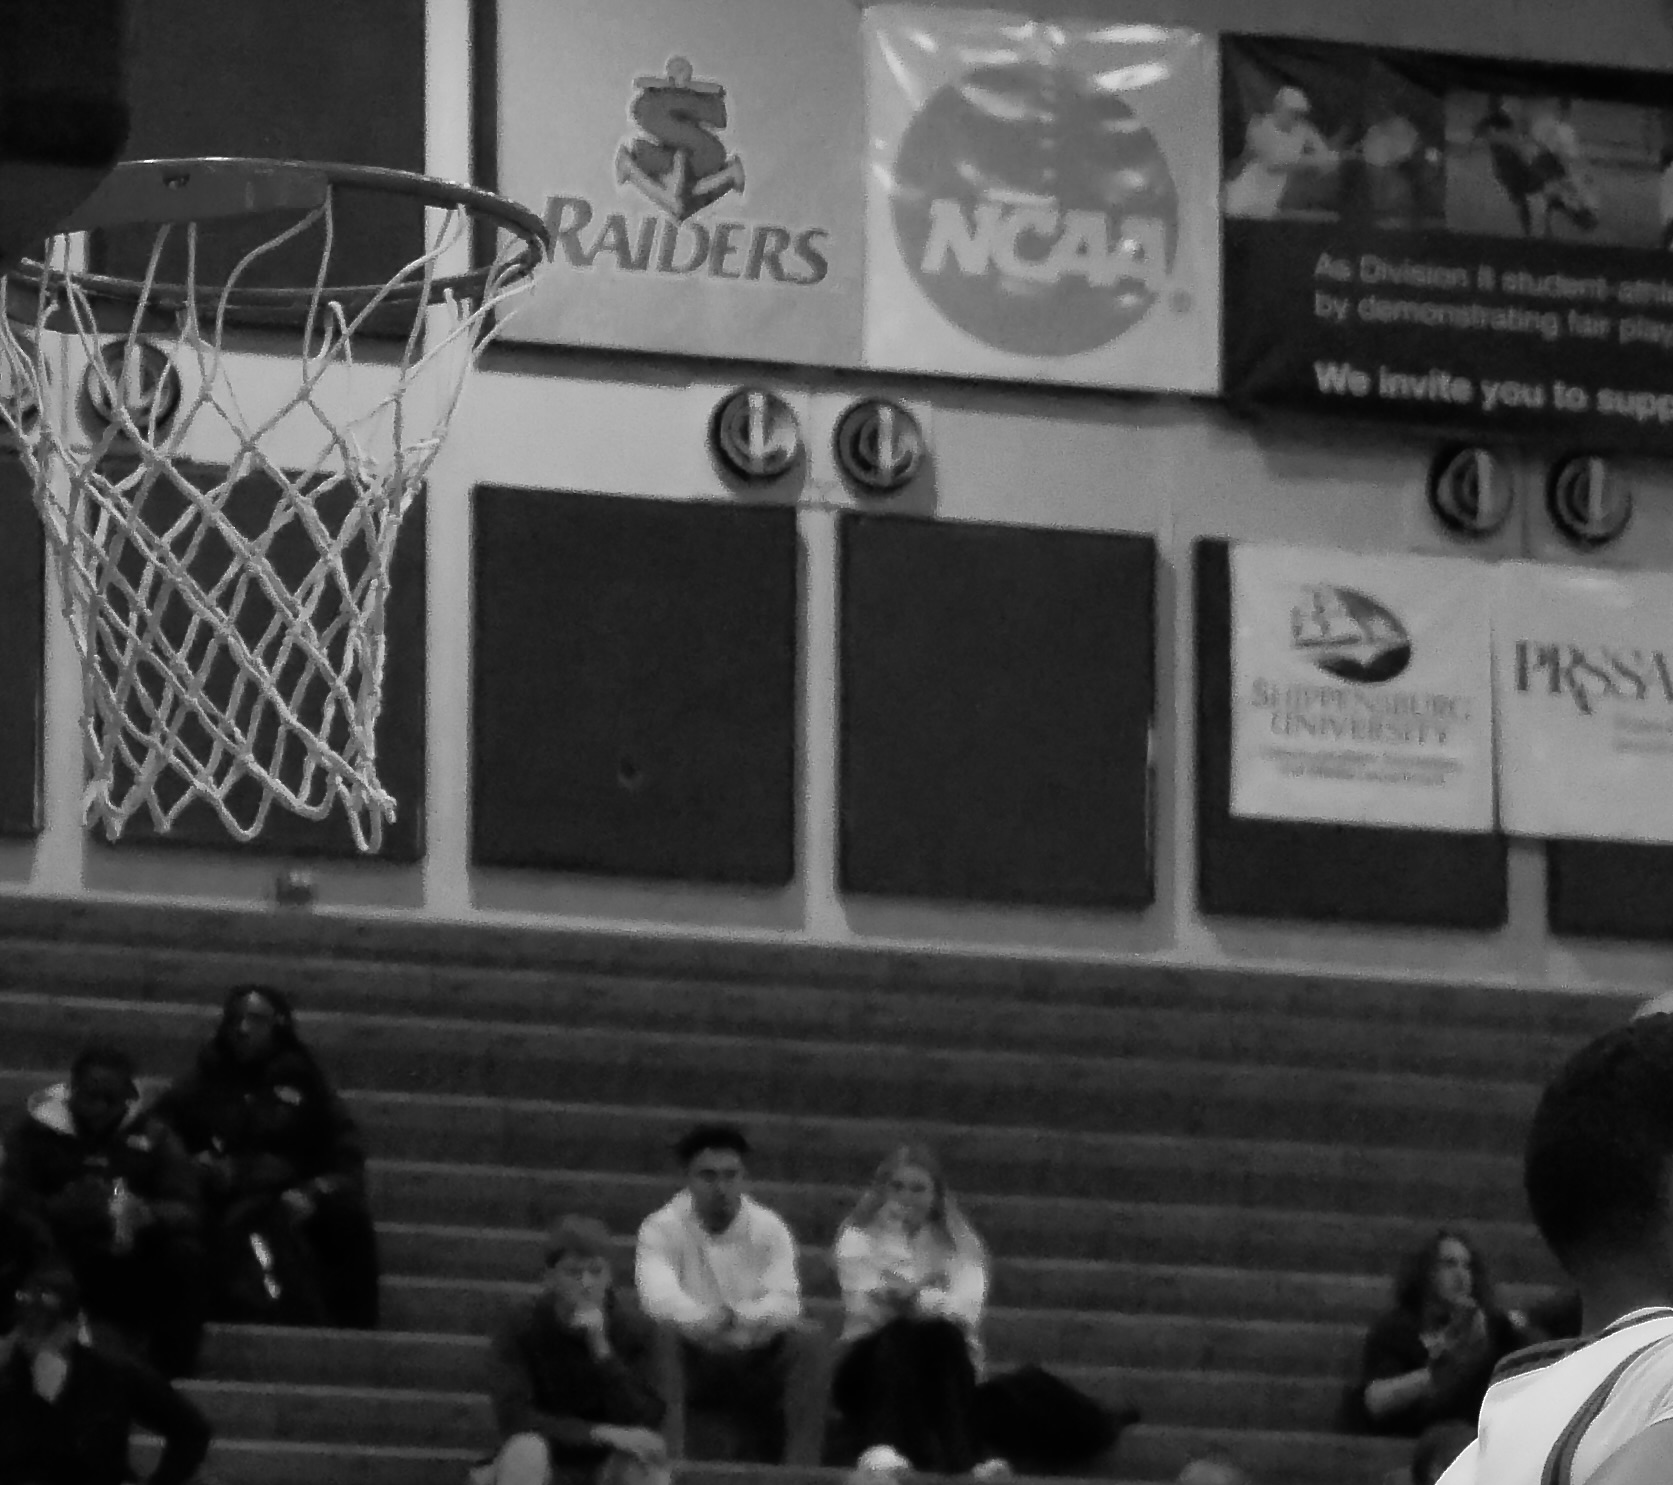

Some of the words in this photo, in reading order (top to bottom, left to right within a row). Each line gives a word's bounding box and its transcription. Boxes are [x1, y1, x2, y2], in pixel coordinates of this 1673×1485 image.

[545, 195, 829, 287] RAIDERS
[920, 198, 1173, 288] NCAA
[1360, 254, 1469, 289] Division
[1314, 289, 1350, 322] by
[1313, 359, 1372, 397] We
[1480, 380, 1545, 412] you
[1552, 378, 1589, 412] to
